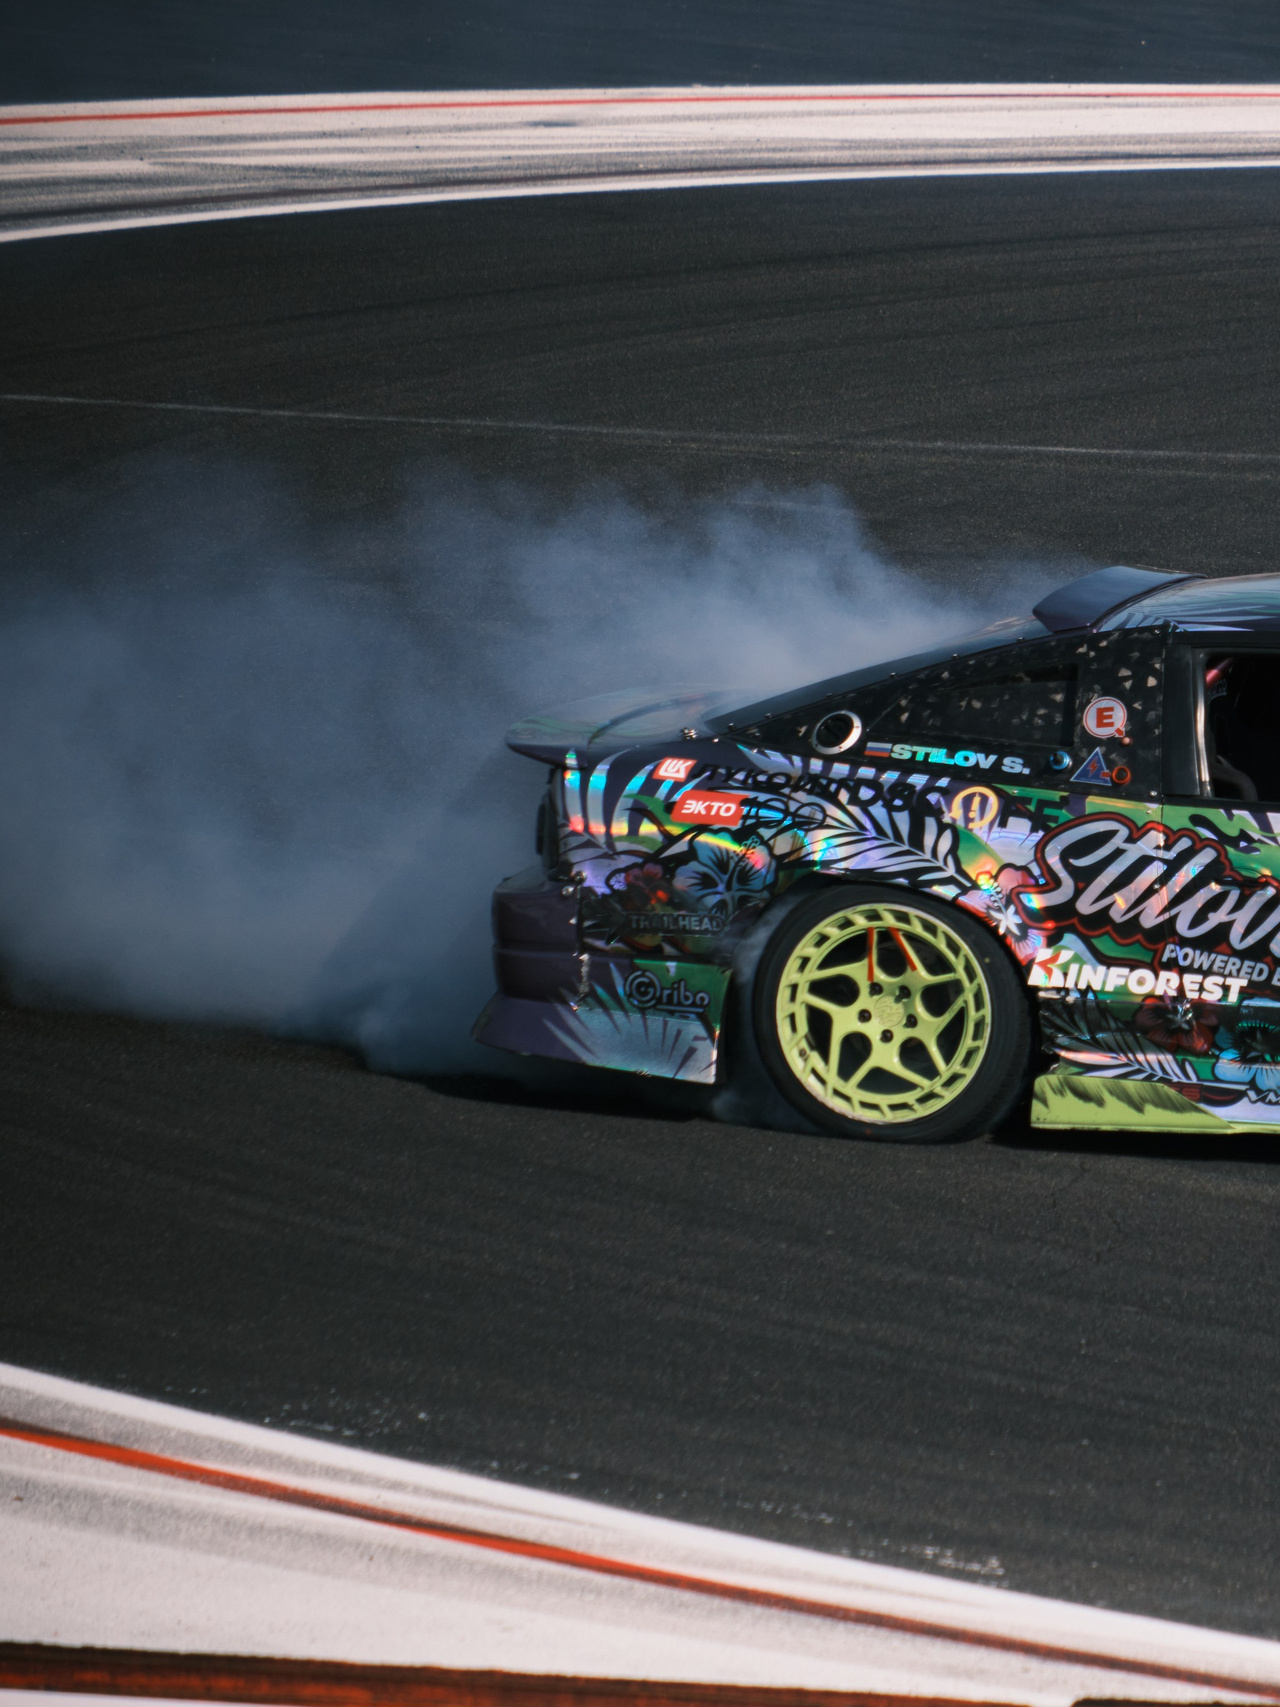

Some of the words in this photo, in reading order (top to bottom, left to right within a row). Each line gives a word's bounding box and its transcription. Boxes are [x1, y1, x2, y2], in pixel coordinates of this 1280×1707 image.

[1096, 707, 1115, 728] E
[890, 744, 998, 769] STILOV
[1001, 756, 1031, 775] S.
[681, 799, 737, 817] ЭКТО
[1028, 949, 1249, 1003] KINFOREST
[1162, 944, 1269, 982] POWERED
